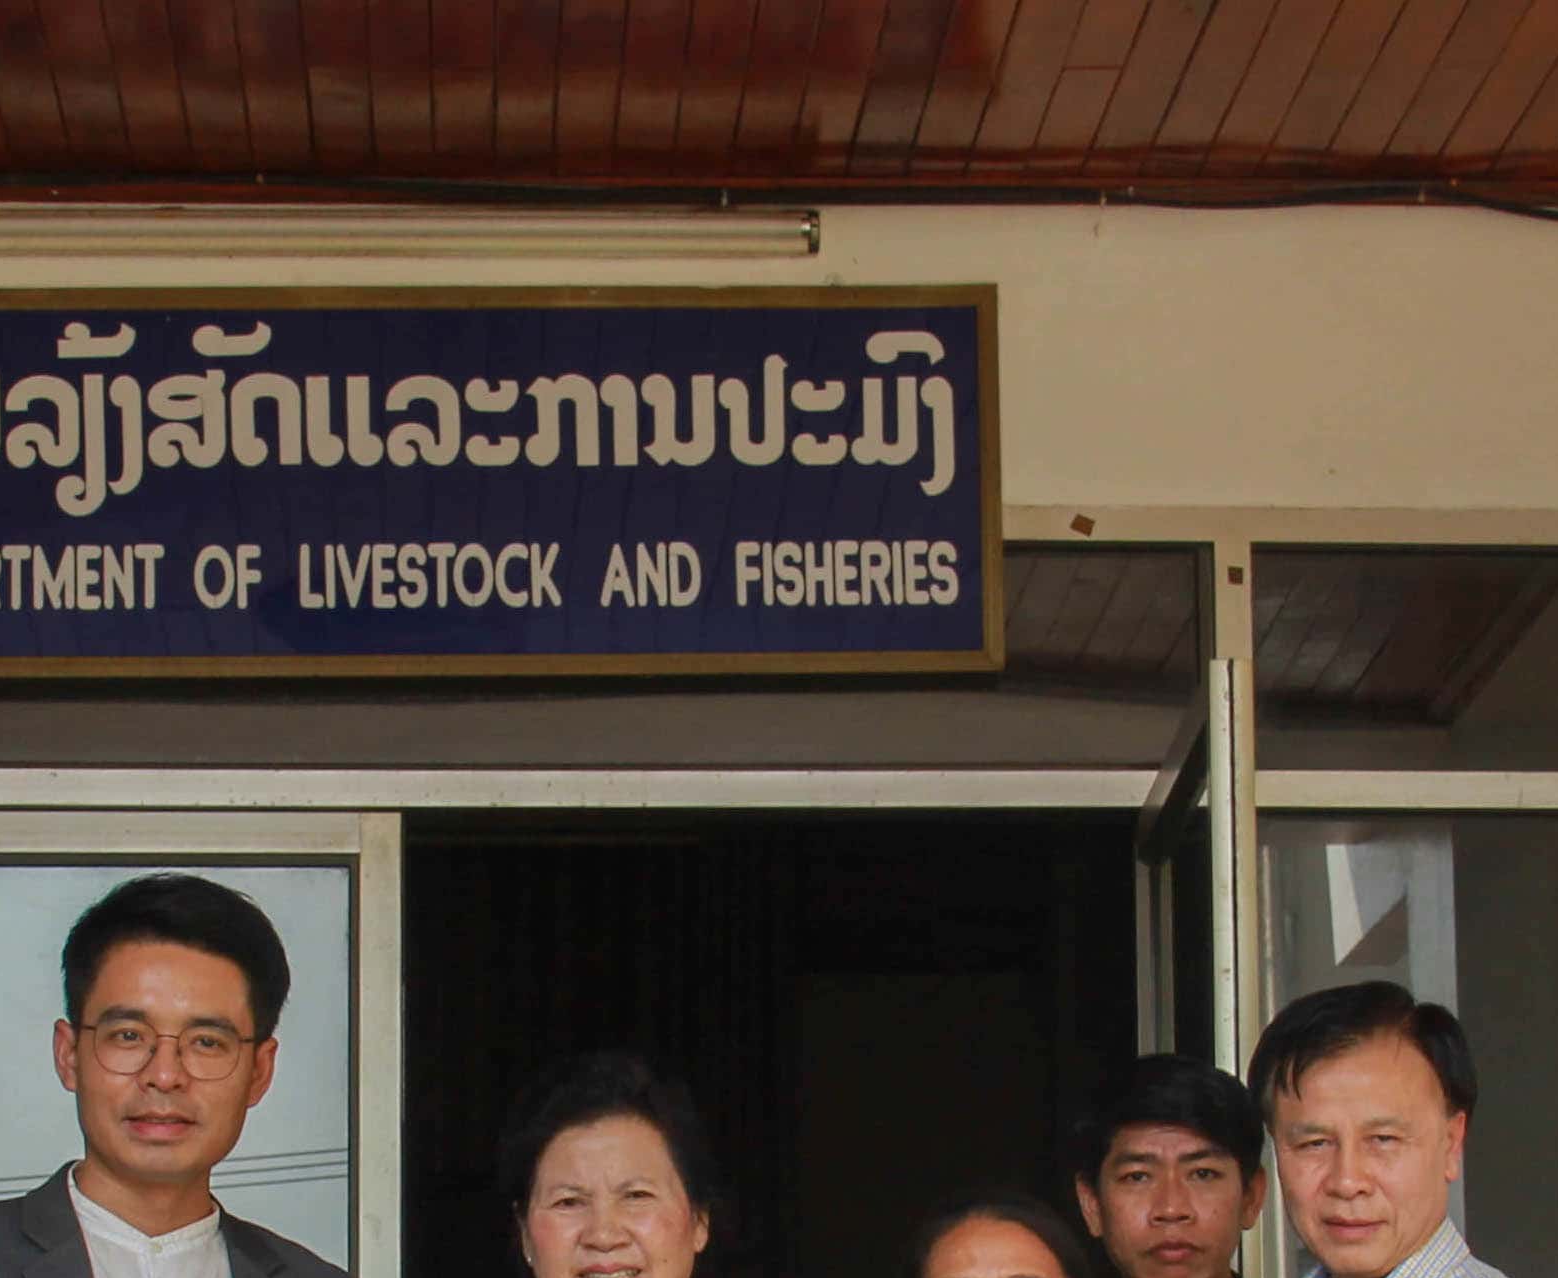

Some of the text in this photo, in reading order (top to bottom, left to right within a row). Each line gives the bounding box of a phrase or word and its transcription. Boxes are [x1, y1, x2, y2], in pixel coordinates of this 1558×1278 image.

[193, 542, 263, 610] OF
[298, 541, 561, 608] LIVESTOCK
[600, 541, 702, 607] AND
[735, 540, 960, 606] FISHERIES
